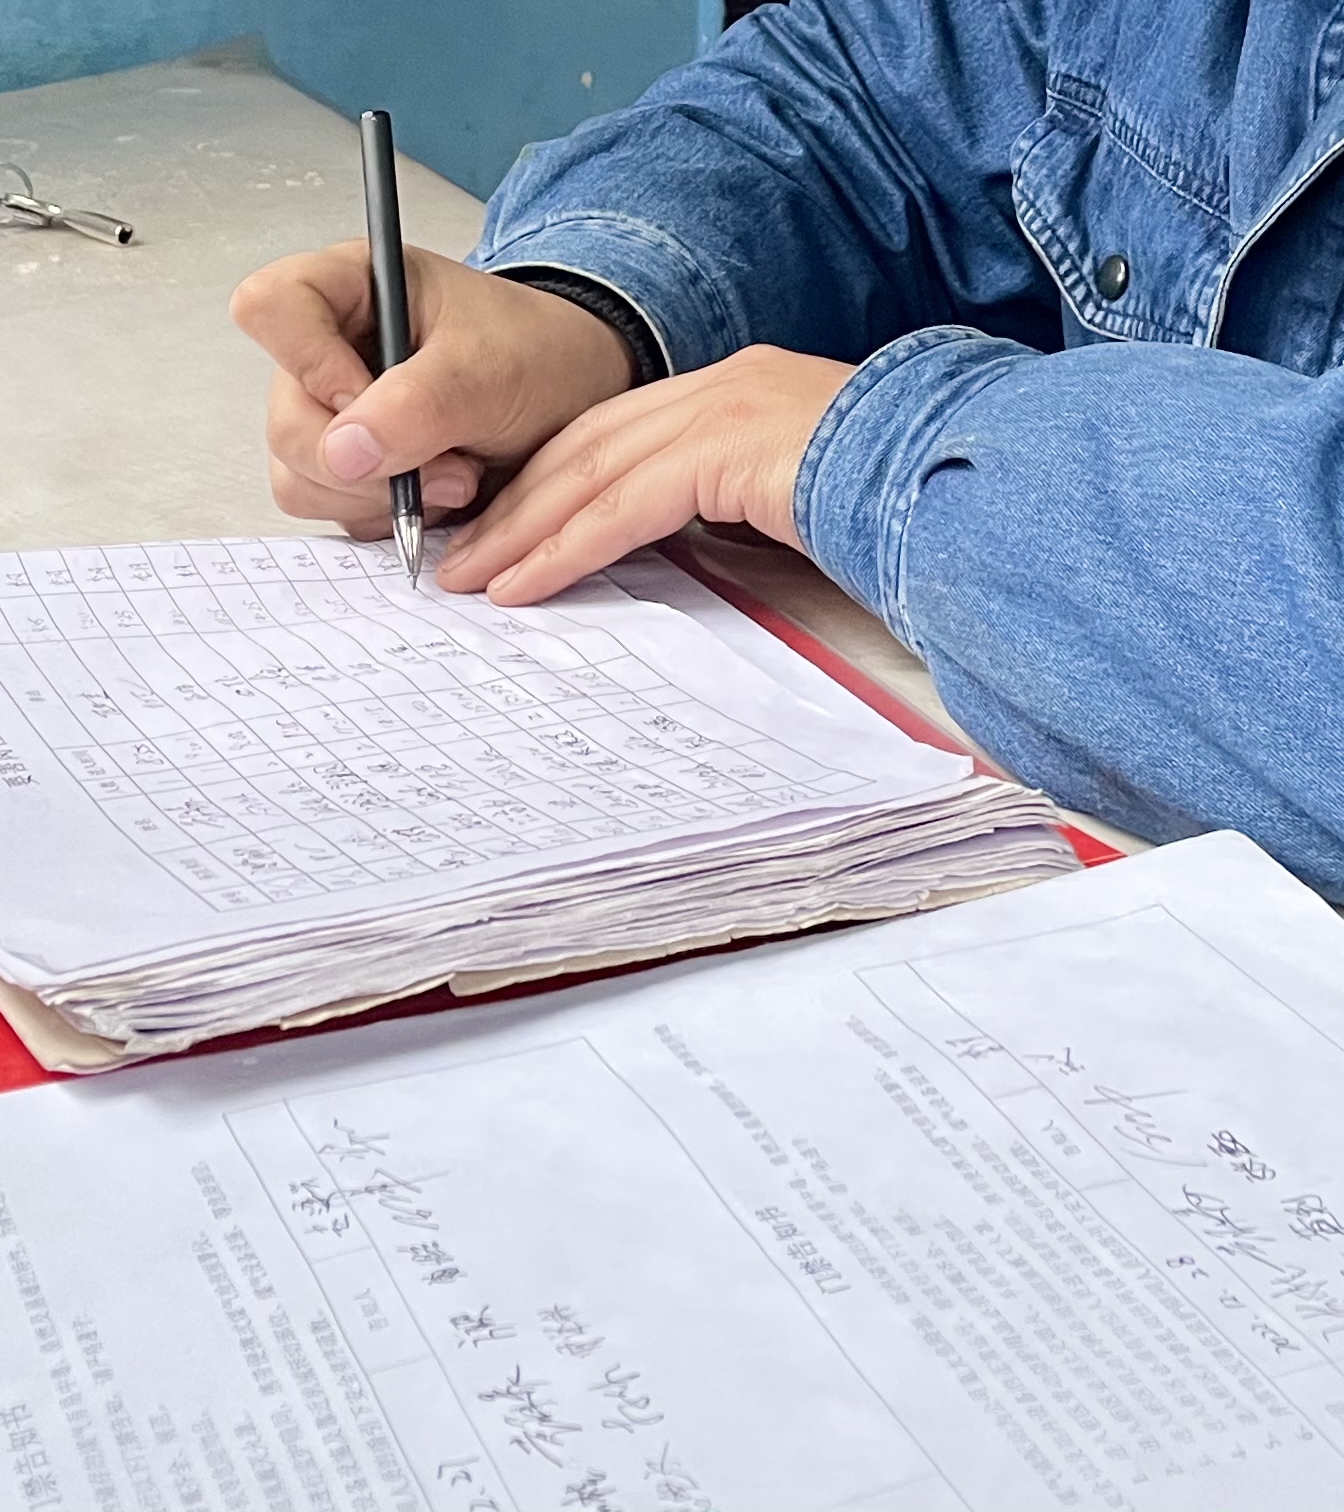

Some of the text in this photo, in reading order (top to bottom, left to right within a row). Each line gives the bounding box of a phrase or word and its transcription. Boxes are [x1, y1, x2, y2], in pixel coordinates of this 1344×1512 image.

[755, 1204, 851, 1294] 门禁告知书
